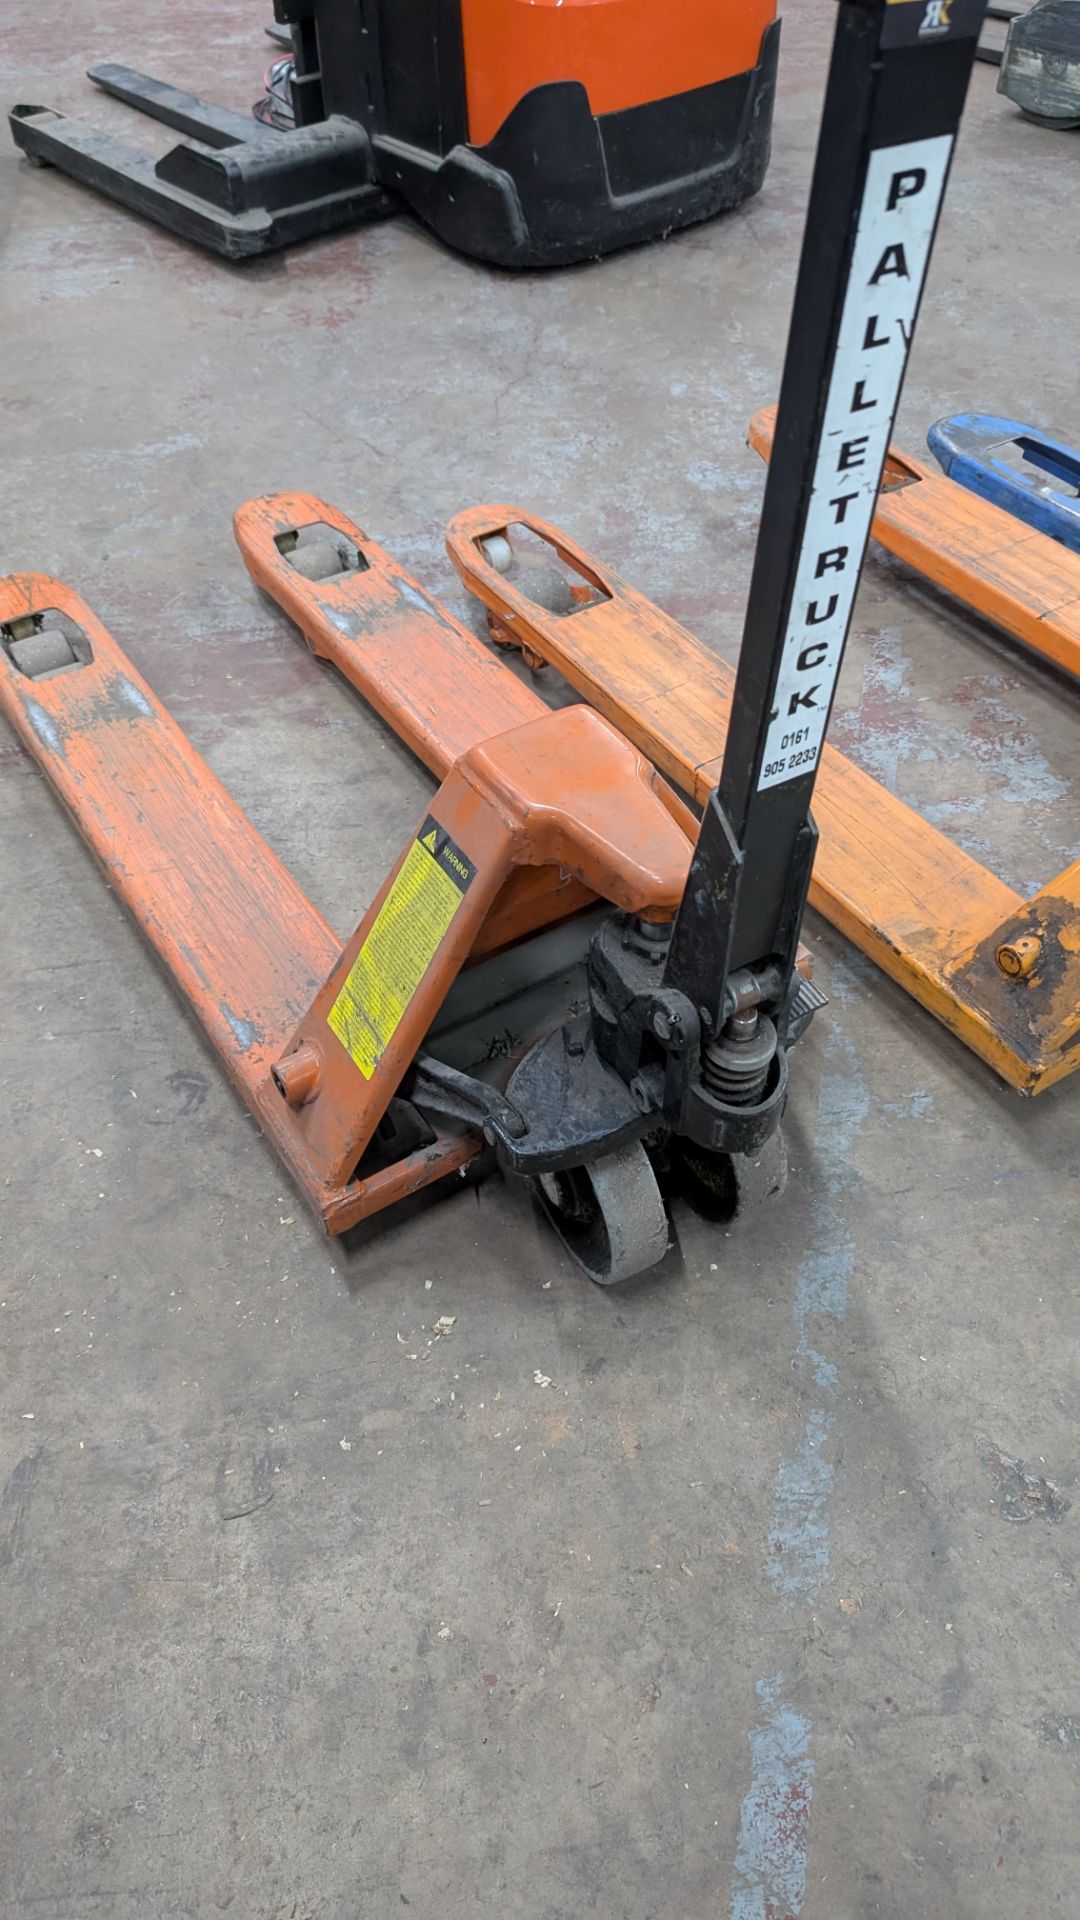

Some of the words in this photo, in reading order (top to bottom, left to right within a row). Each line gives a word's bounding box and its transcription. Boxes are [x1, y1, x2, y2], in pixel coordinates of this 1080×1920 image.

[781, 726, 810, 750] 0161
[763, 758, 786, 778] 905
[788, 746, 818, 769] 2233
[443, 845, 469, 880] WARNING
